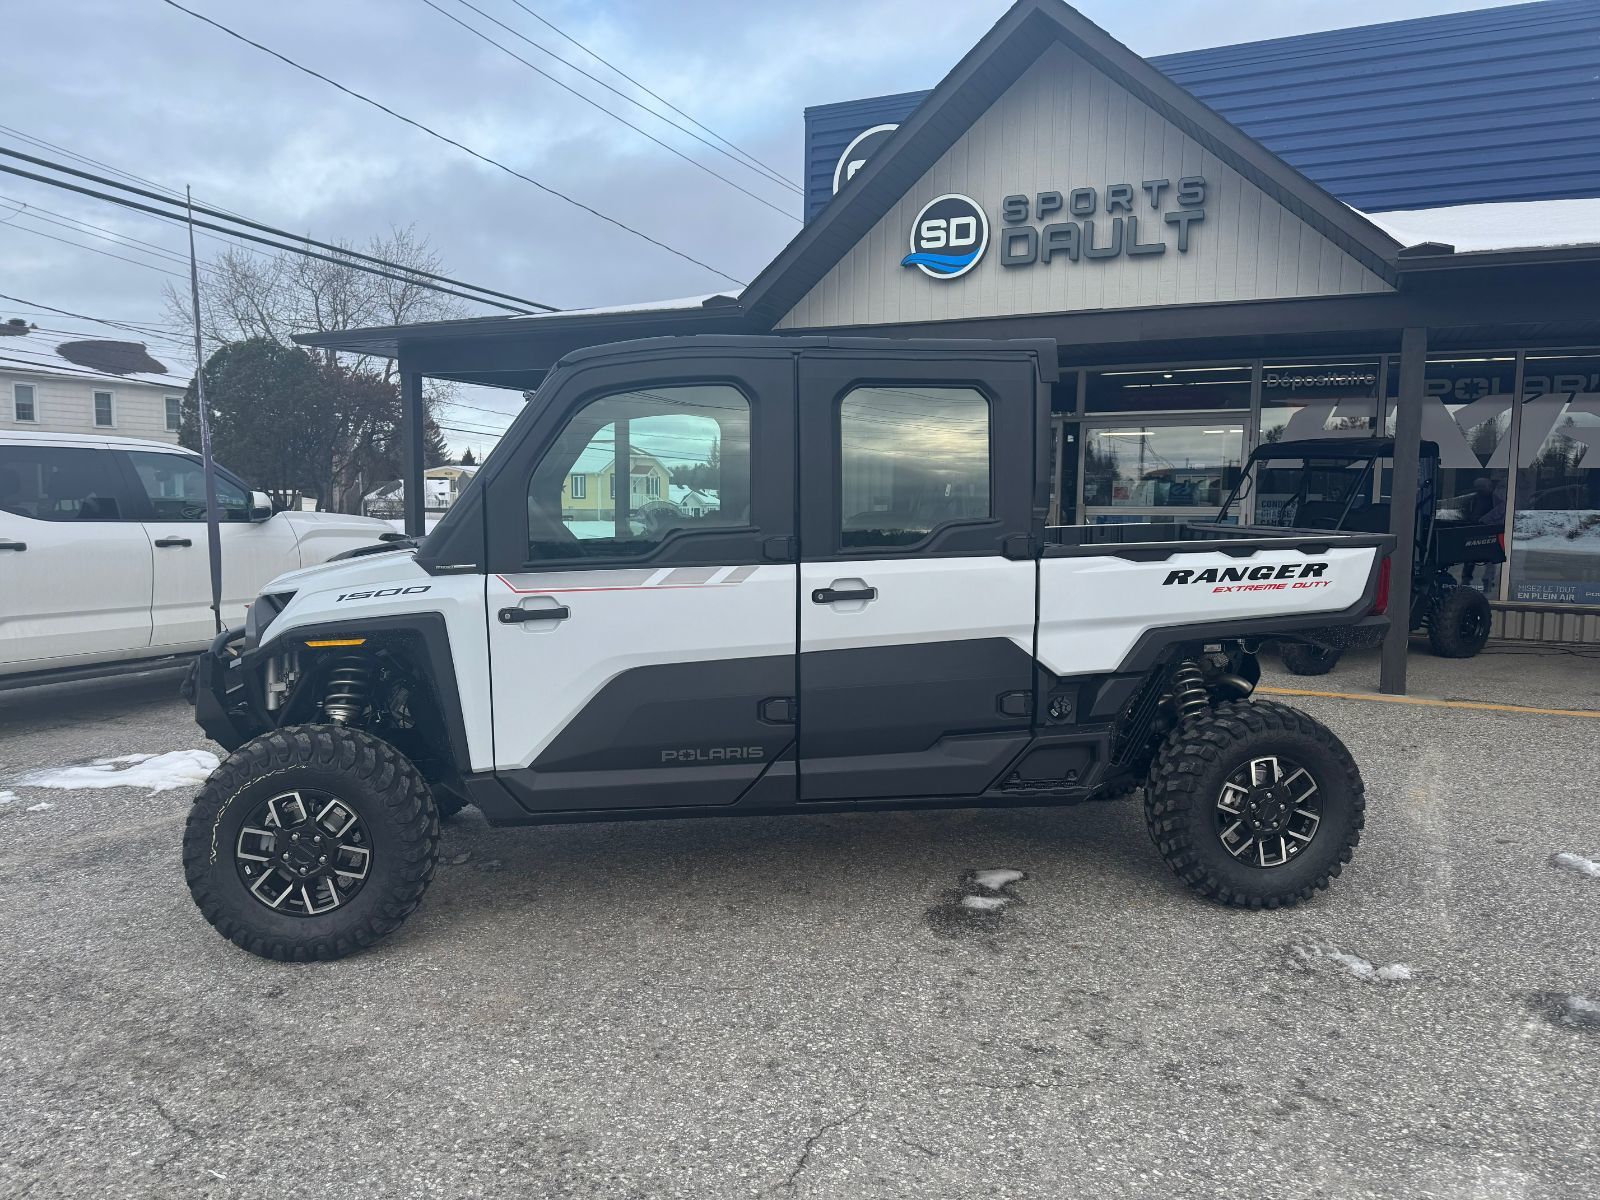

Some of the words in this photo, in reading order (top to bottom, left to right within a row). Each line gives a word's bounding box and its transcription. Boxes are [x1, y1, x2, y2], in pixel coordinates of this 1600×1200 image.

[1002, 175, 1206, 222] SPORTS
[920, 216, 977, 249] SD
[1001, 209, 1205, 267] DAULT
[1266, 371, 1376, 391] Dépositaire
[1162, 562, 1329, 585] RANGER
[336, 585, 432, 602] 1500
[1212, 582, 1288, 594] EXTREME
[1292, 580, 1333, 589] DUTY
[1517, 584, 1542, 592] MISEZ
[1543, 585, 1553, 593] LE
[1559, 593, 1575, 601] AIR
[661, 746, 765, 762] POLARIS
